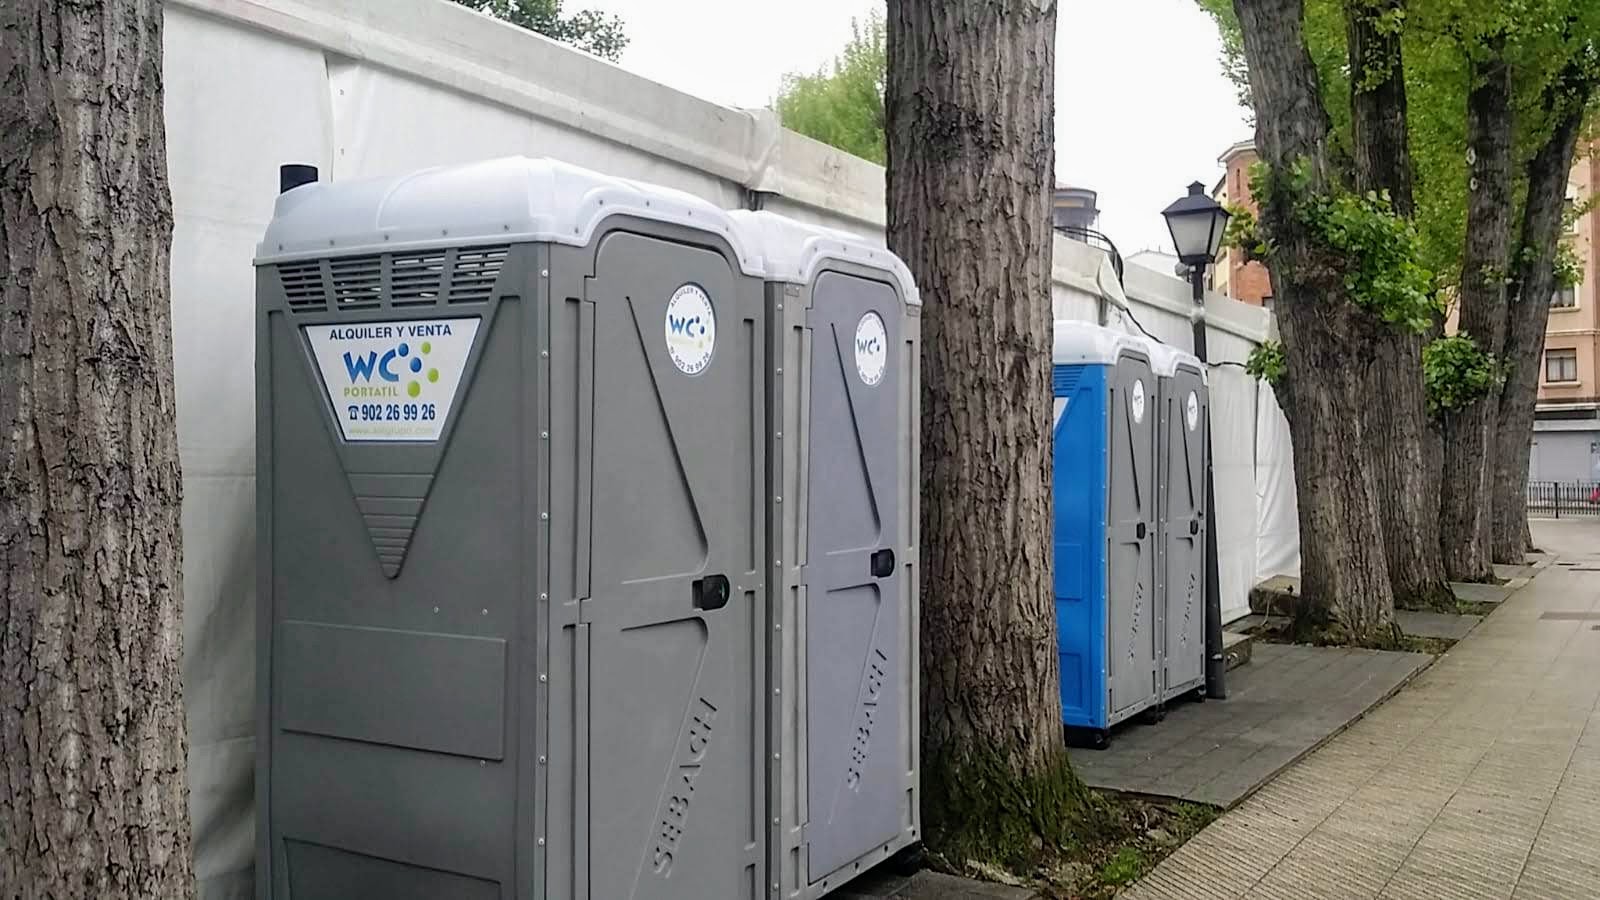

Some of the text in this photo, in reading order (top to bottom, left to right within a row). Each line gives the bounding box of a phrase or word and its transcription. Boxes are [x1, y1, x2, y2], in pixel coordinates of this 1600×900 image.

[330, 324, 452, 340] ALQUILER Y VENTA
[669, 314, 694, 337] WC
[857, 338, 874, 355] WC
[343, 348, 399, 384] WC
[344, 386, 399, 397] PORTATIL
[362, 404, 435, 420] 902 26 99 26
